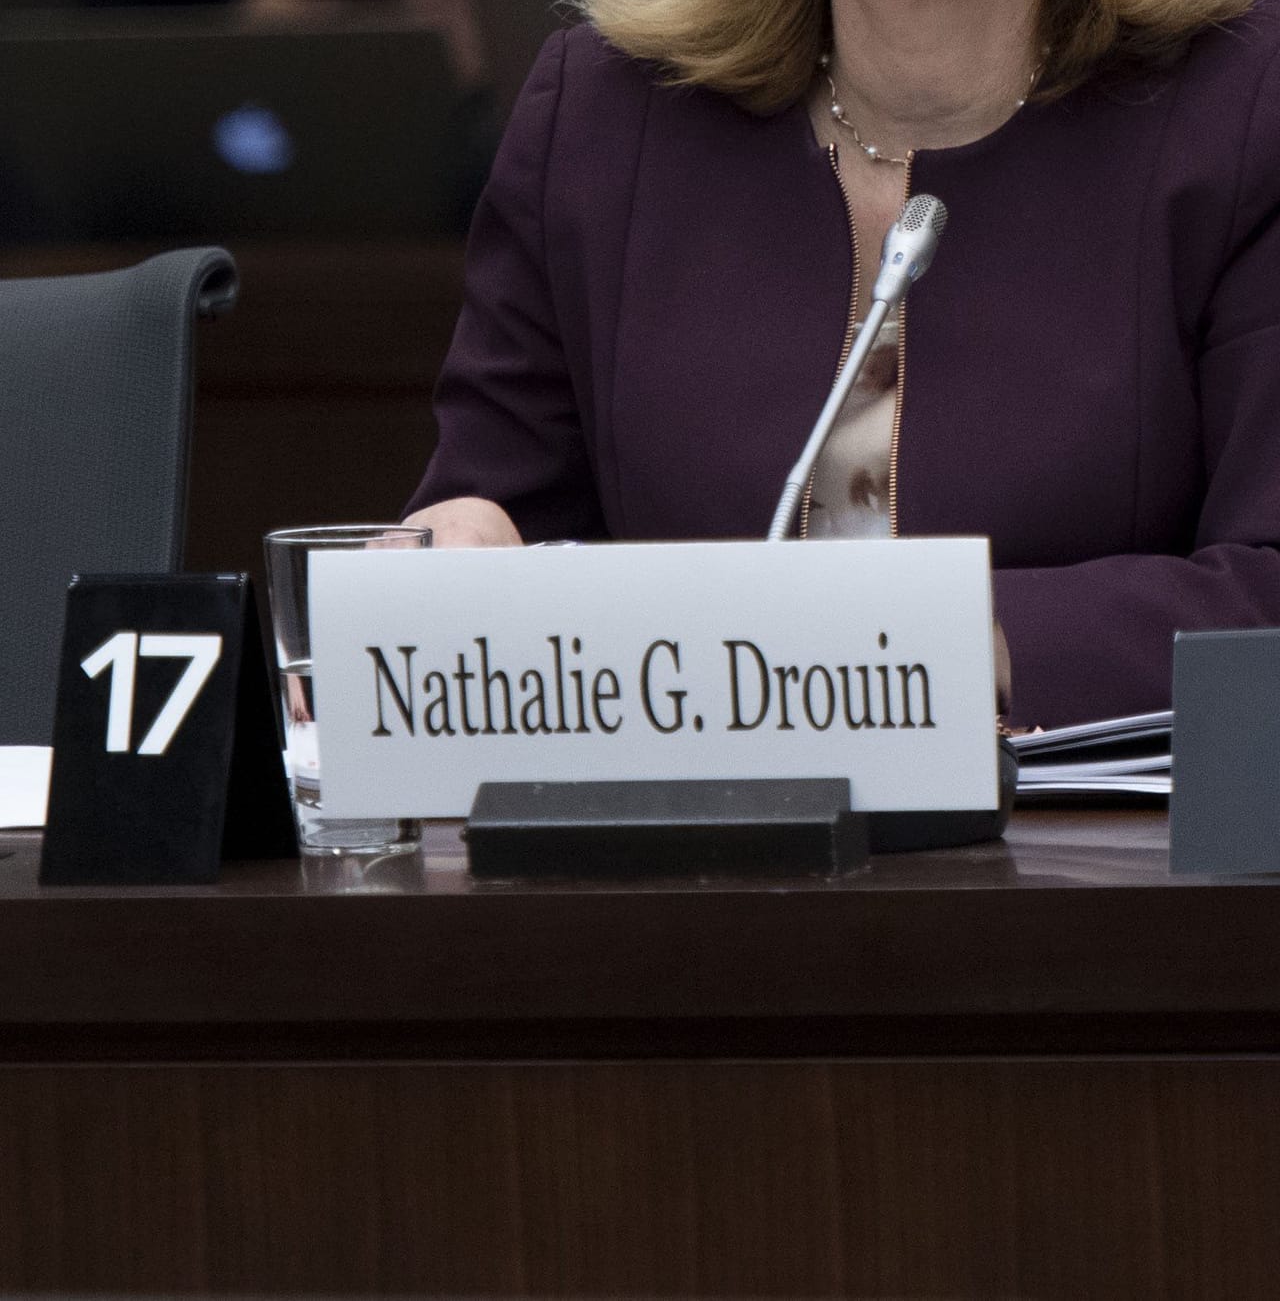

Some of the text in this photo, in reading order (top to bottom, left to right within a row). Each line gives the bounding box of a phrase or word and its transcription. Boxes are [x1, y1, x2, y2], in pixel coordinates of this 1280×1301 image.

[79, 631, 223, 756] 17
[365, 631, 937, 738] Nathalie G. Drouin
